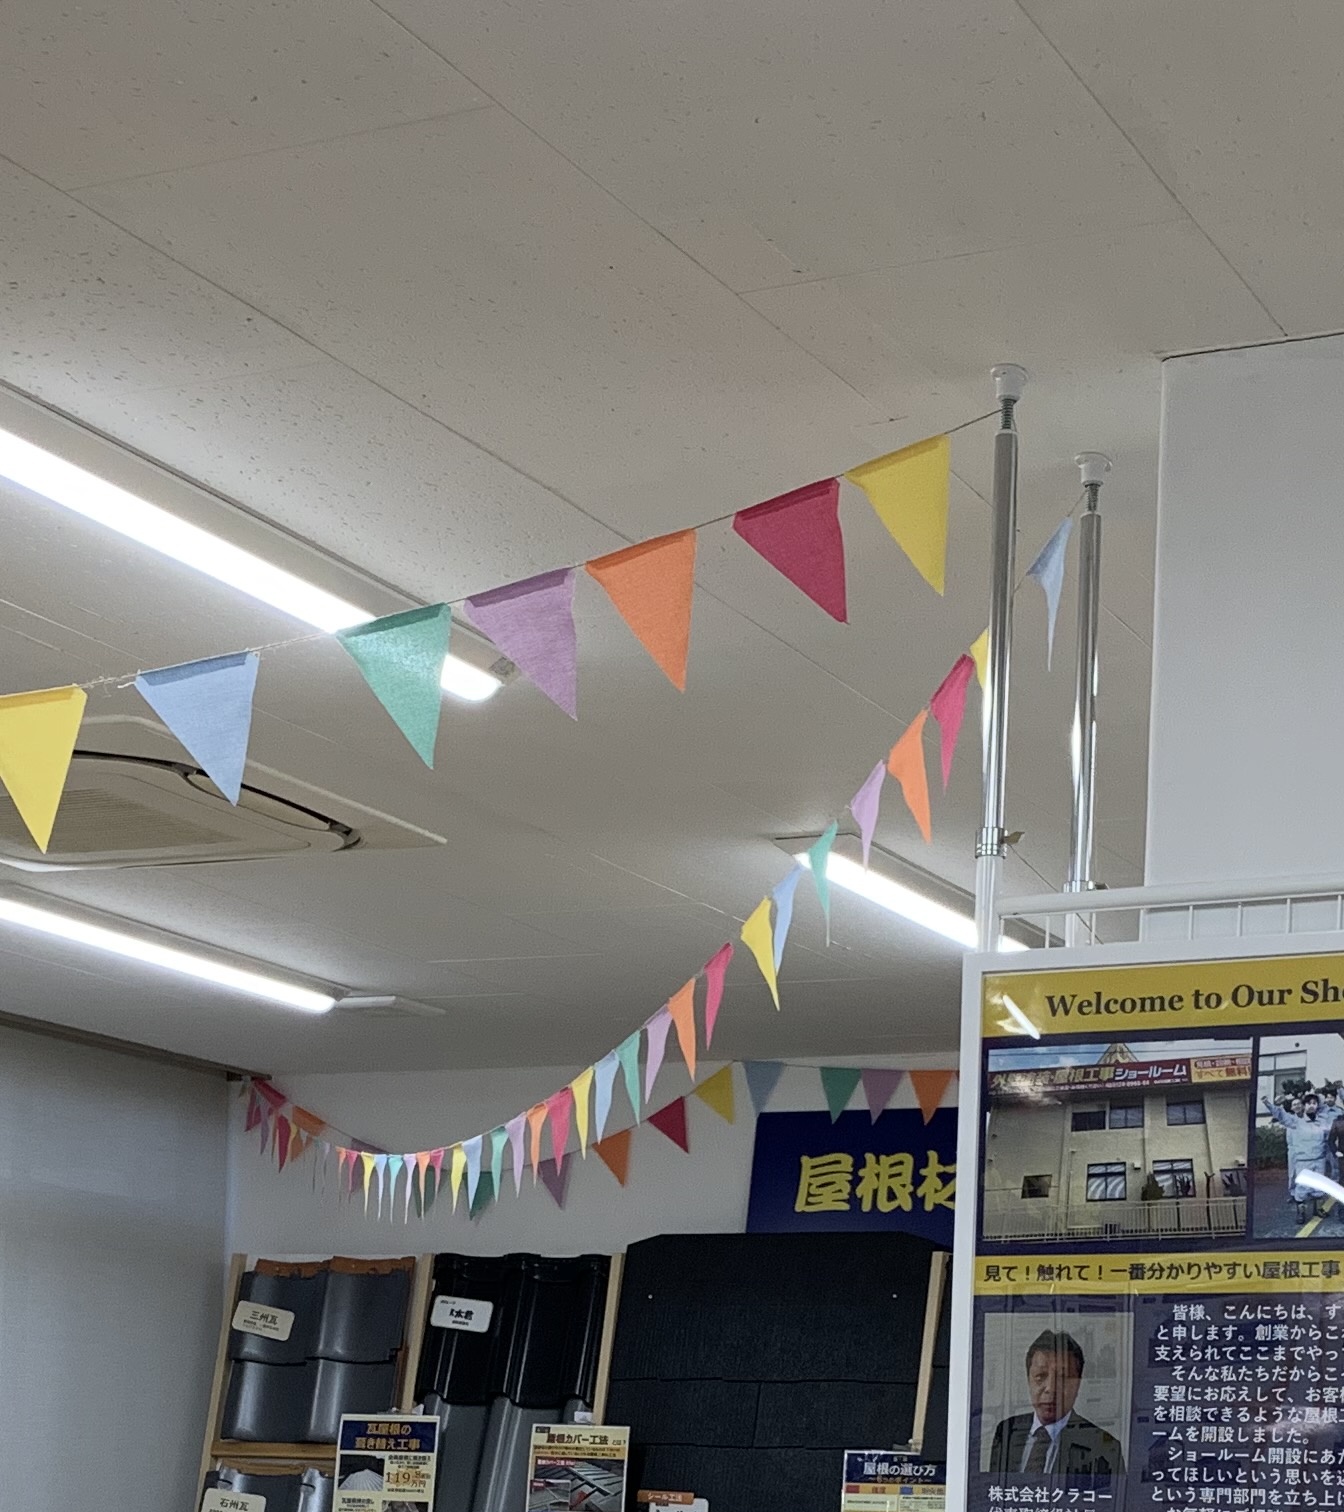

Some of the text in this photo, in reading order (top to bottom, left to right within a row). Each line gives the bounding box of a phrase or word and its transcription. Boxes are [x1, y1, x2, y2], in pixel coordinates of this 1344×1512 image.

[1045, 991, 1184, 1018] Welcome
[1192, 989, 1223, 1010] to
[1231, 983, 1293, 1008] Our
[988, 1485, 1113, 1504] 株式会社クラコー
